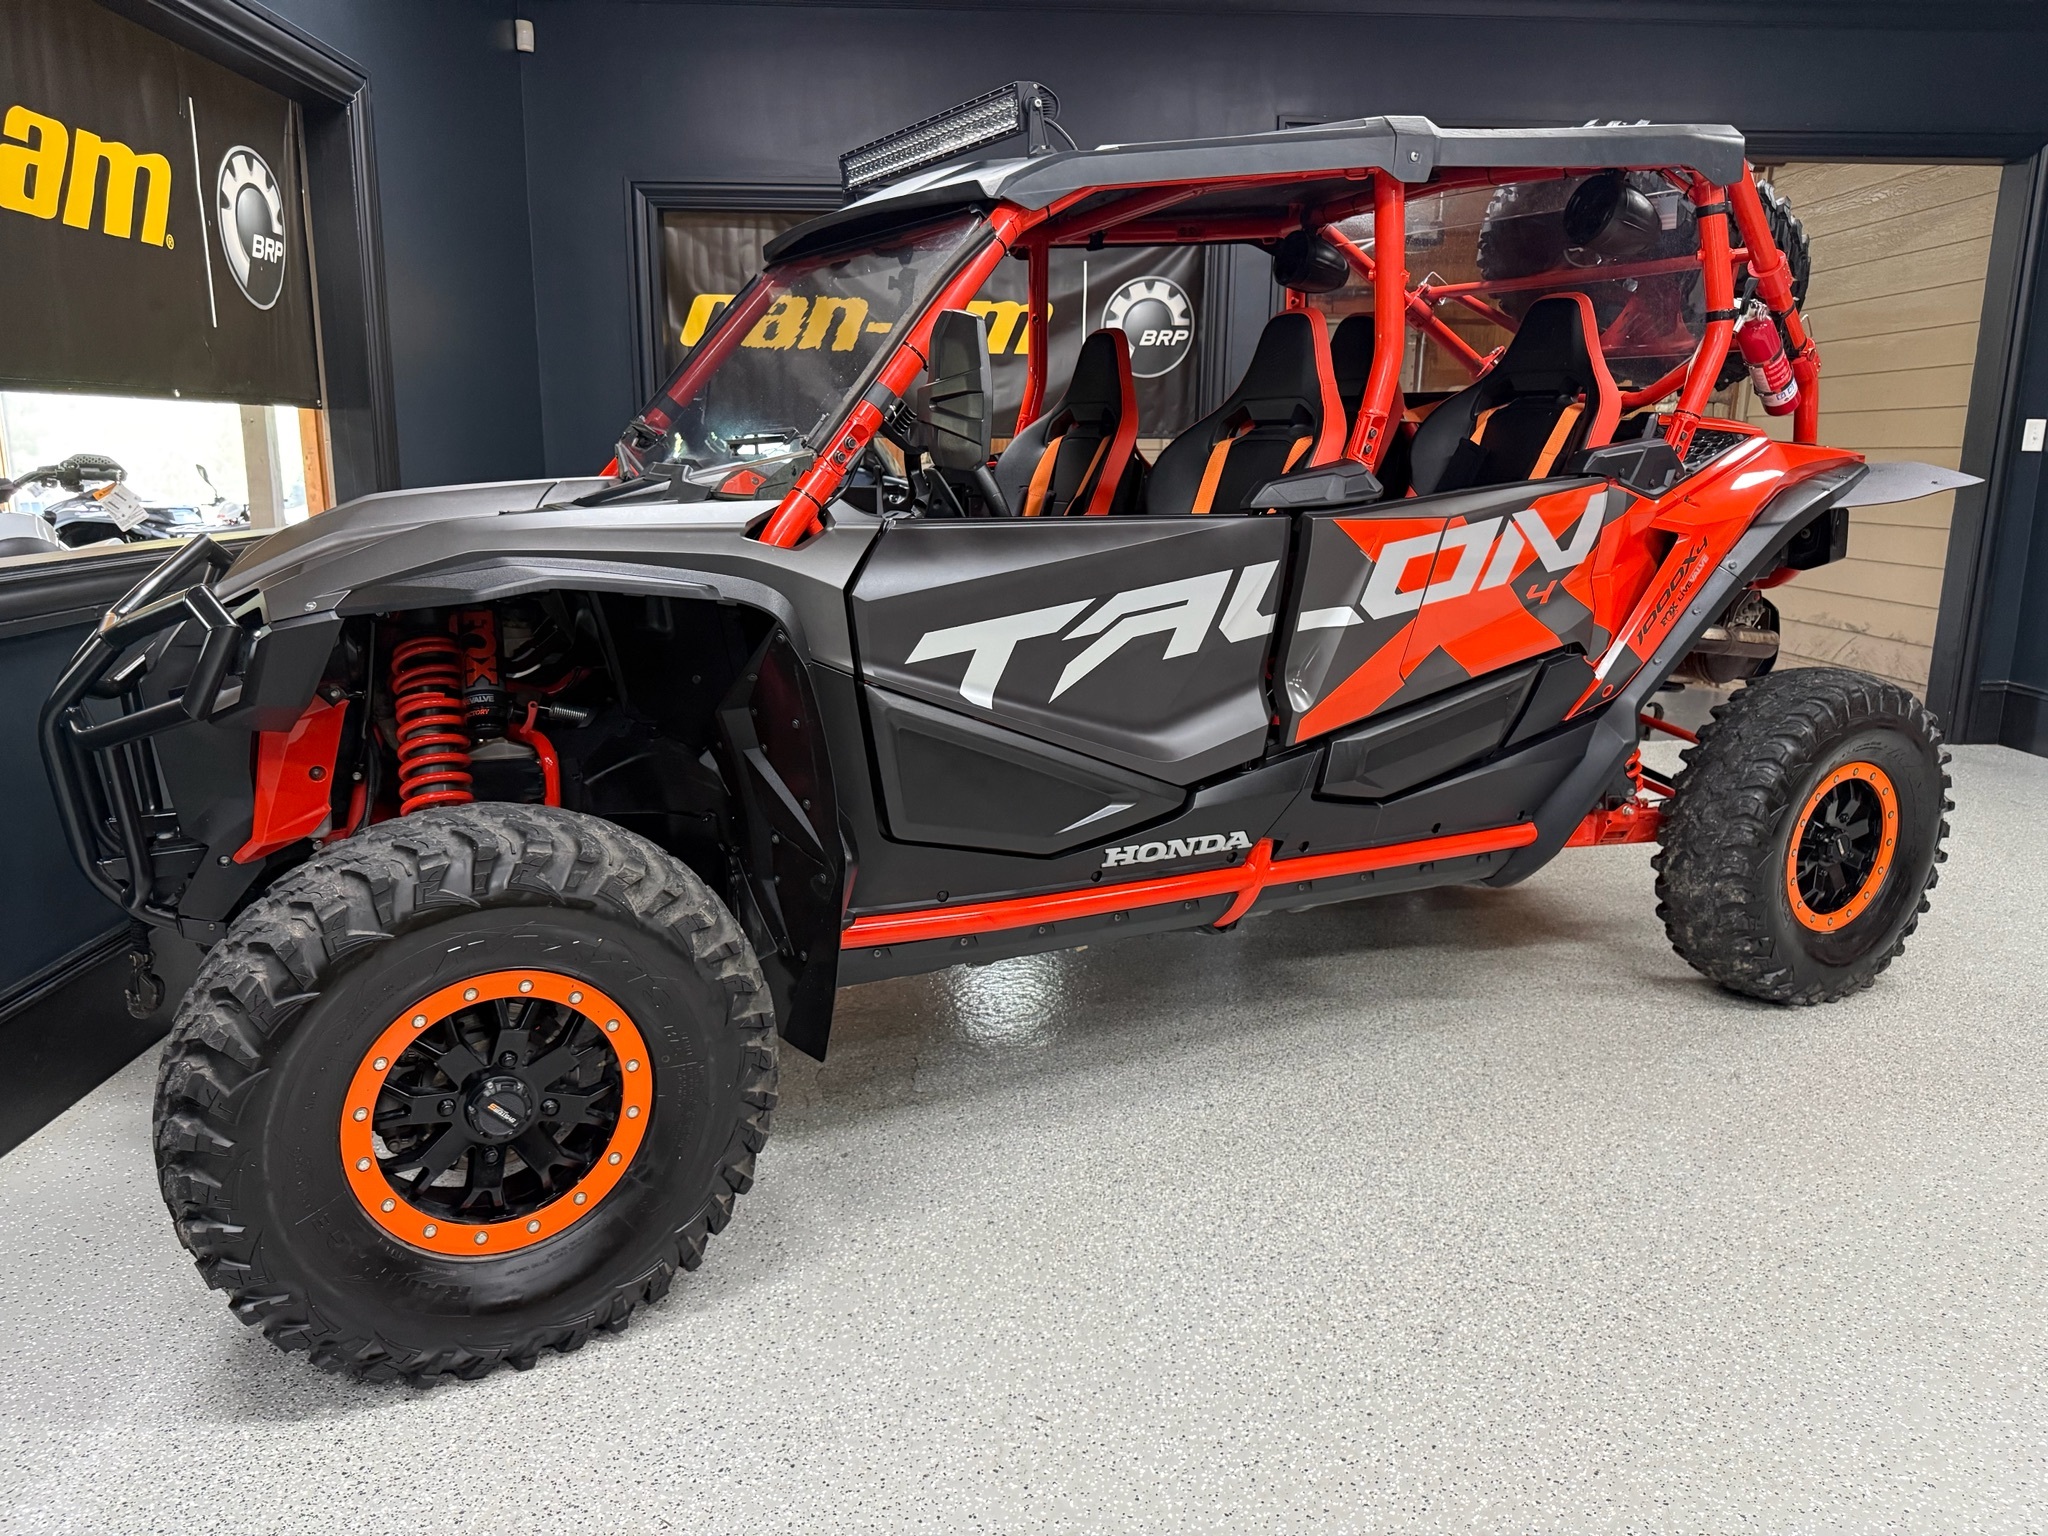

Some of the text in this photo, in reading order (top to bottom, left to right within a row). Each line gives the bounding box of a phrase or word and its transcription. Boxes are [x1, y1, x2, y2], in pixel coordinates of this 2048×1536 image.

[252, 234, 284, 263] BRP
[1139, 330, 1189, 346] BRP
[905, 494, 1606, 709] TALON
[1526, 579, 1558, 604] 4
[1101, 831, 1253, 868] HONDA
